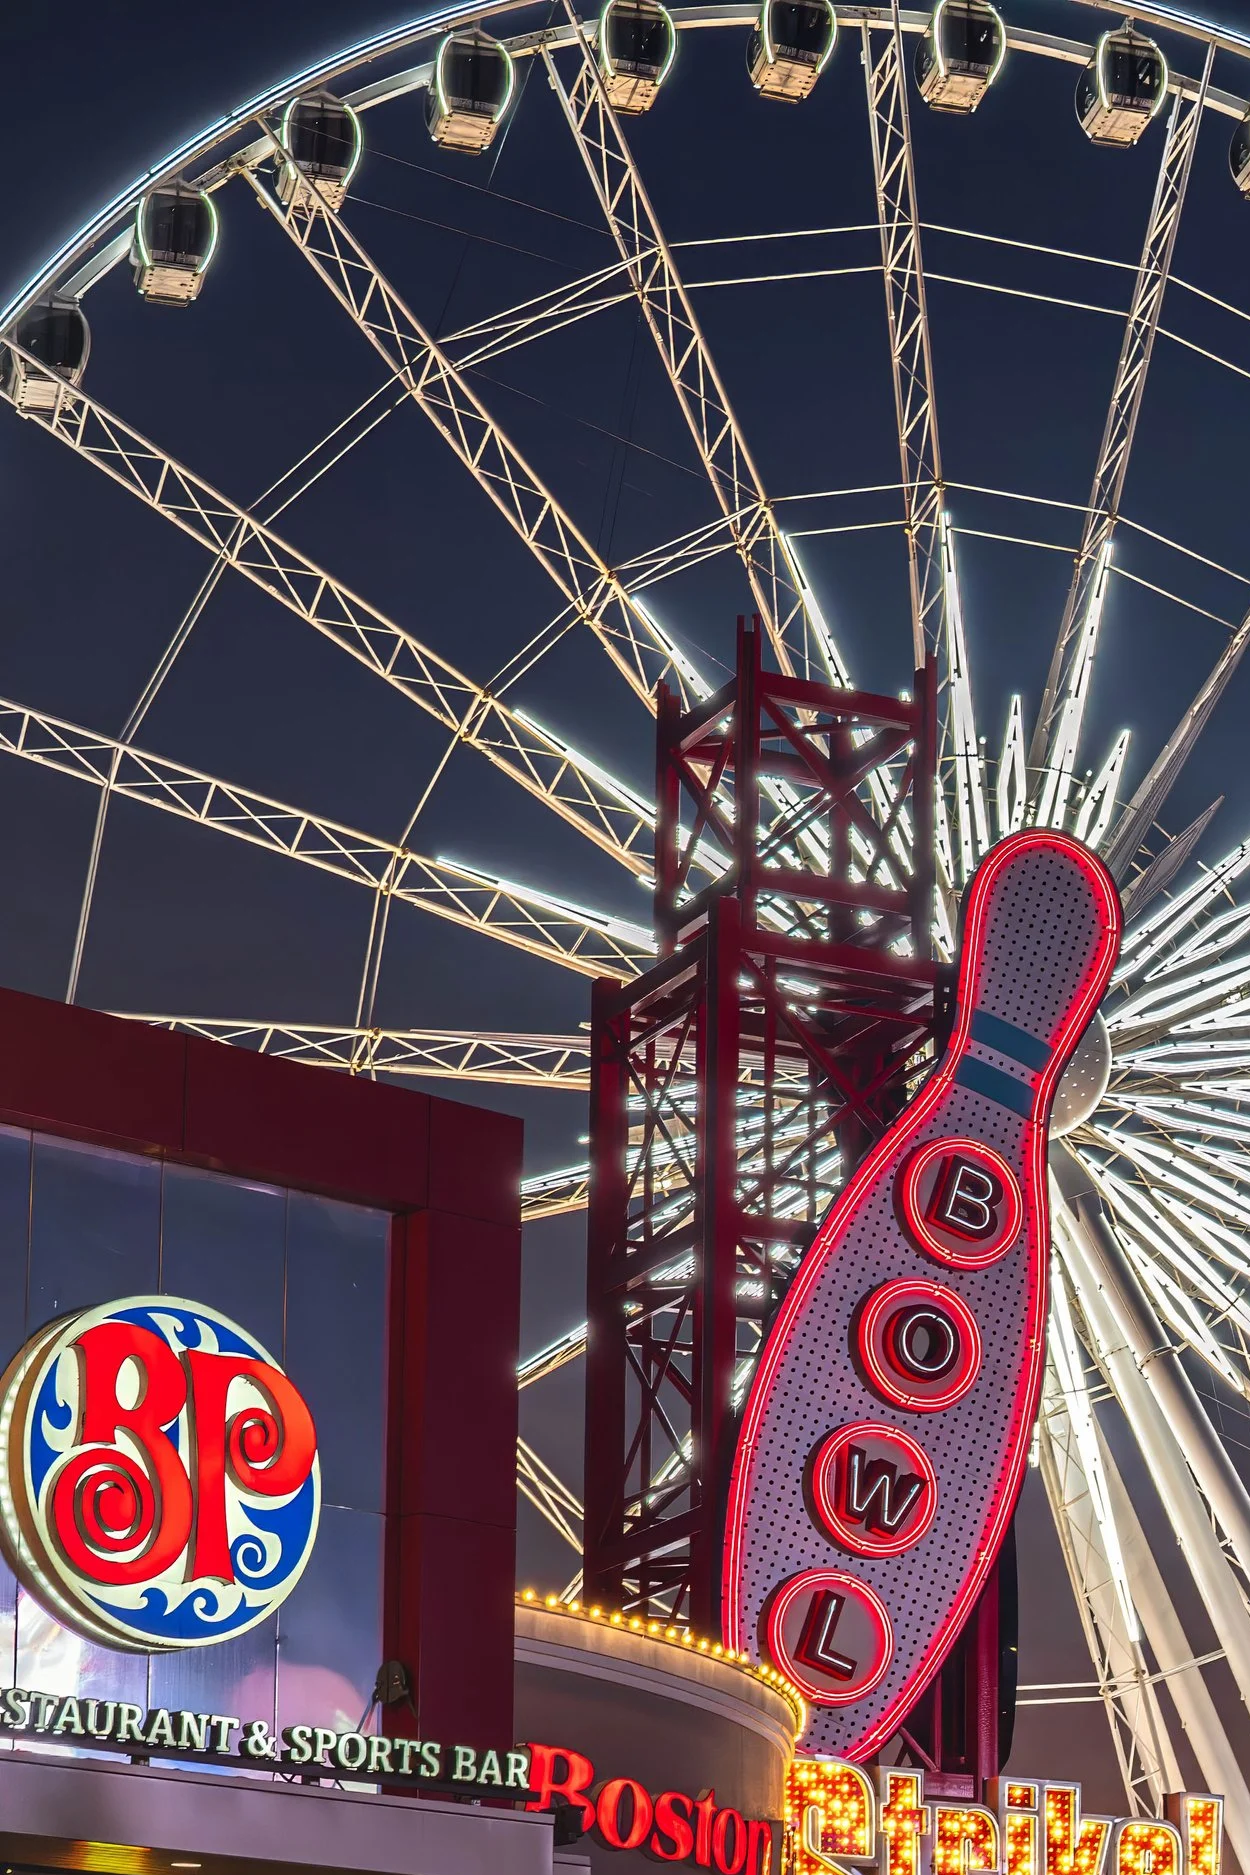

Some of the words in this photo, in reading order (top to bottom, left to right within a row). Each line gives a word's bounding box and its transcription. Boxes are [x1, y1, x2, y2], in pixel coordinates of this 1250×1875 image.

[53, 1321, 318, 1585] BP
[793, 1155, 1003, 1683] BOWL
[0, 1688, 240, 1752] STAURANT
[247, 1720, 277, 1759] &
[290, 1725, 442, 1777] SPORTS
[452, 1745, 531, 1789] BAR
